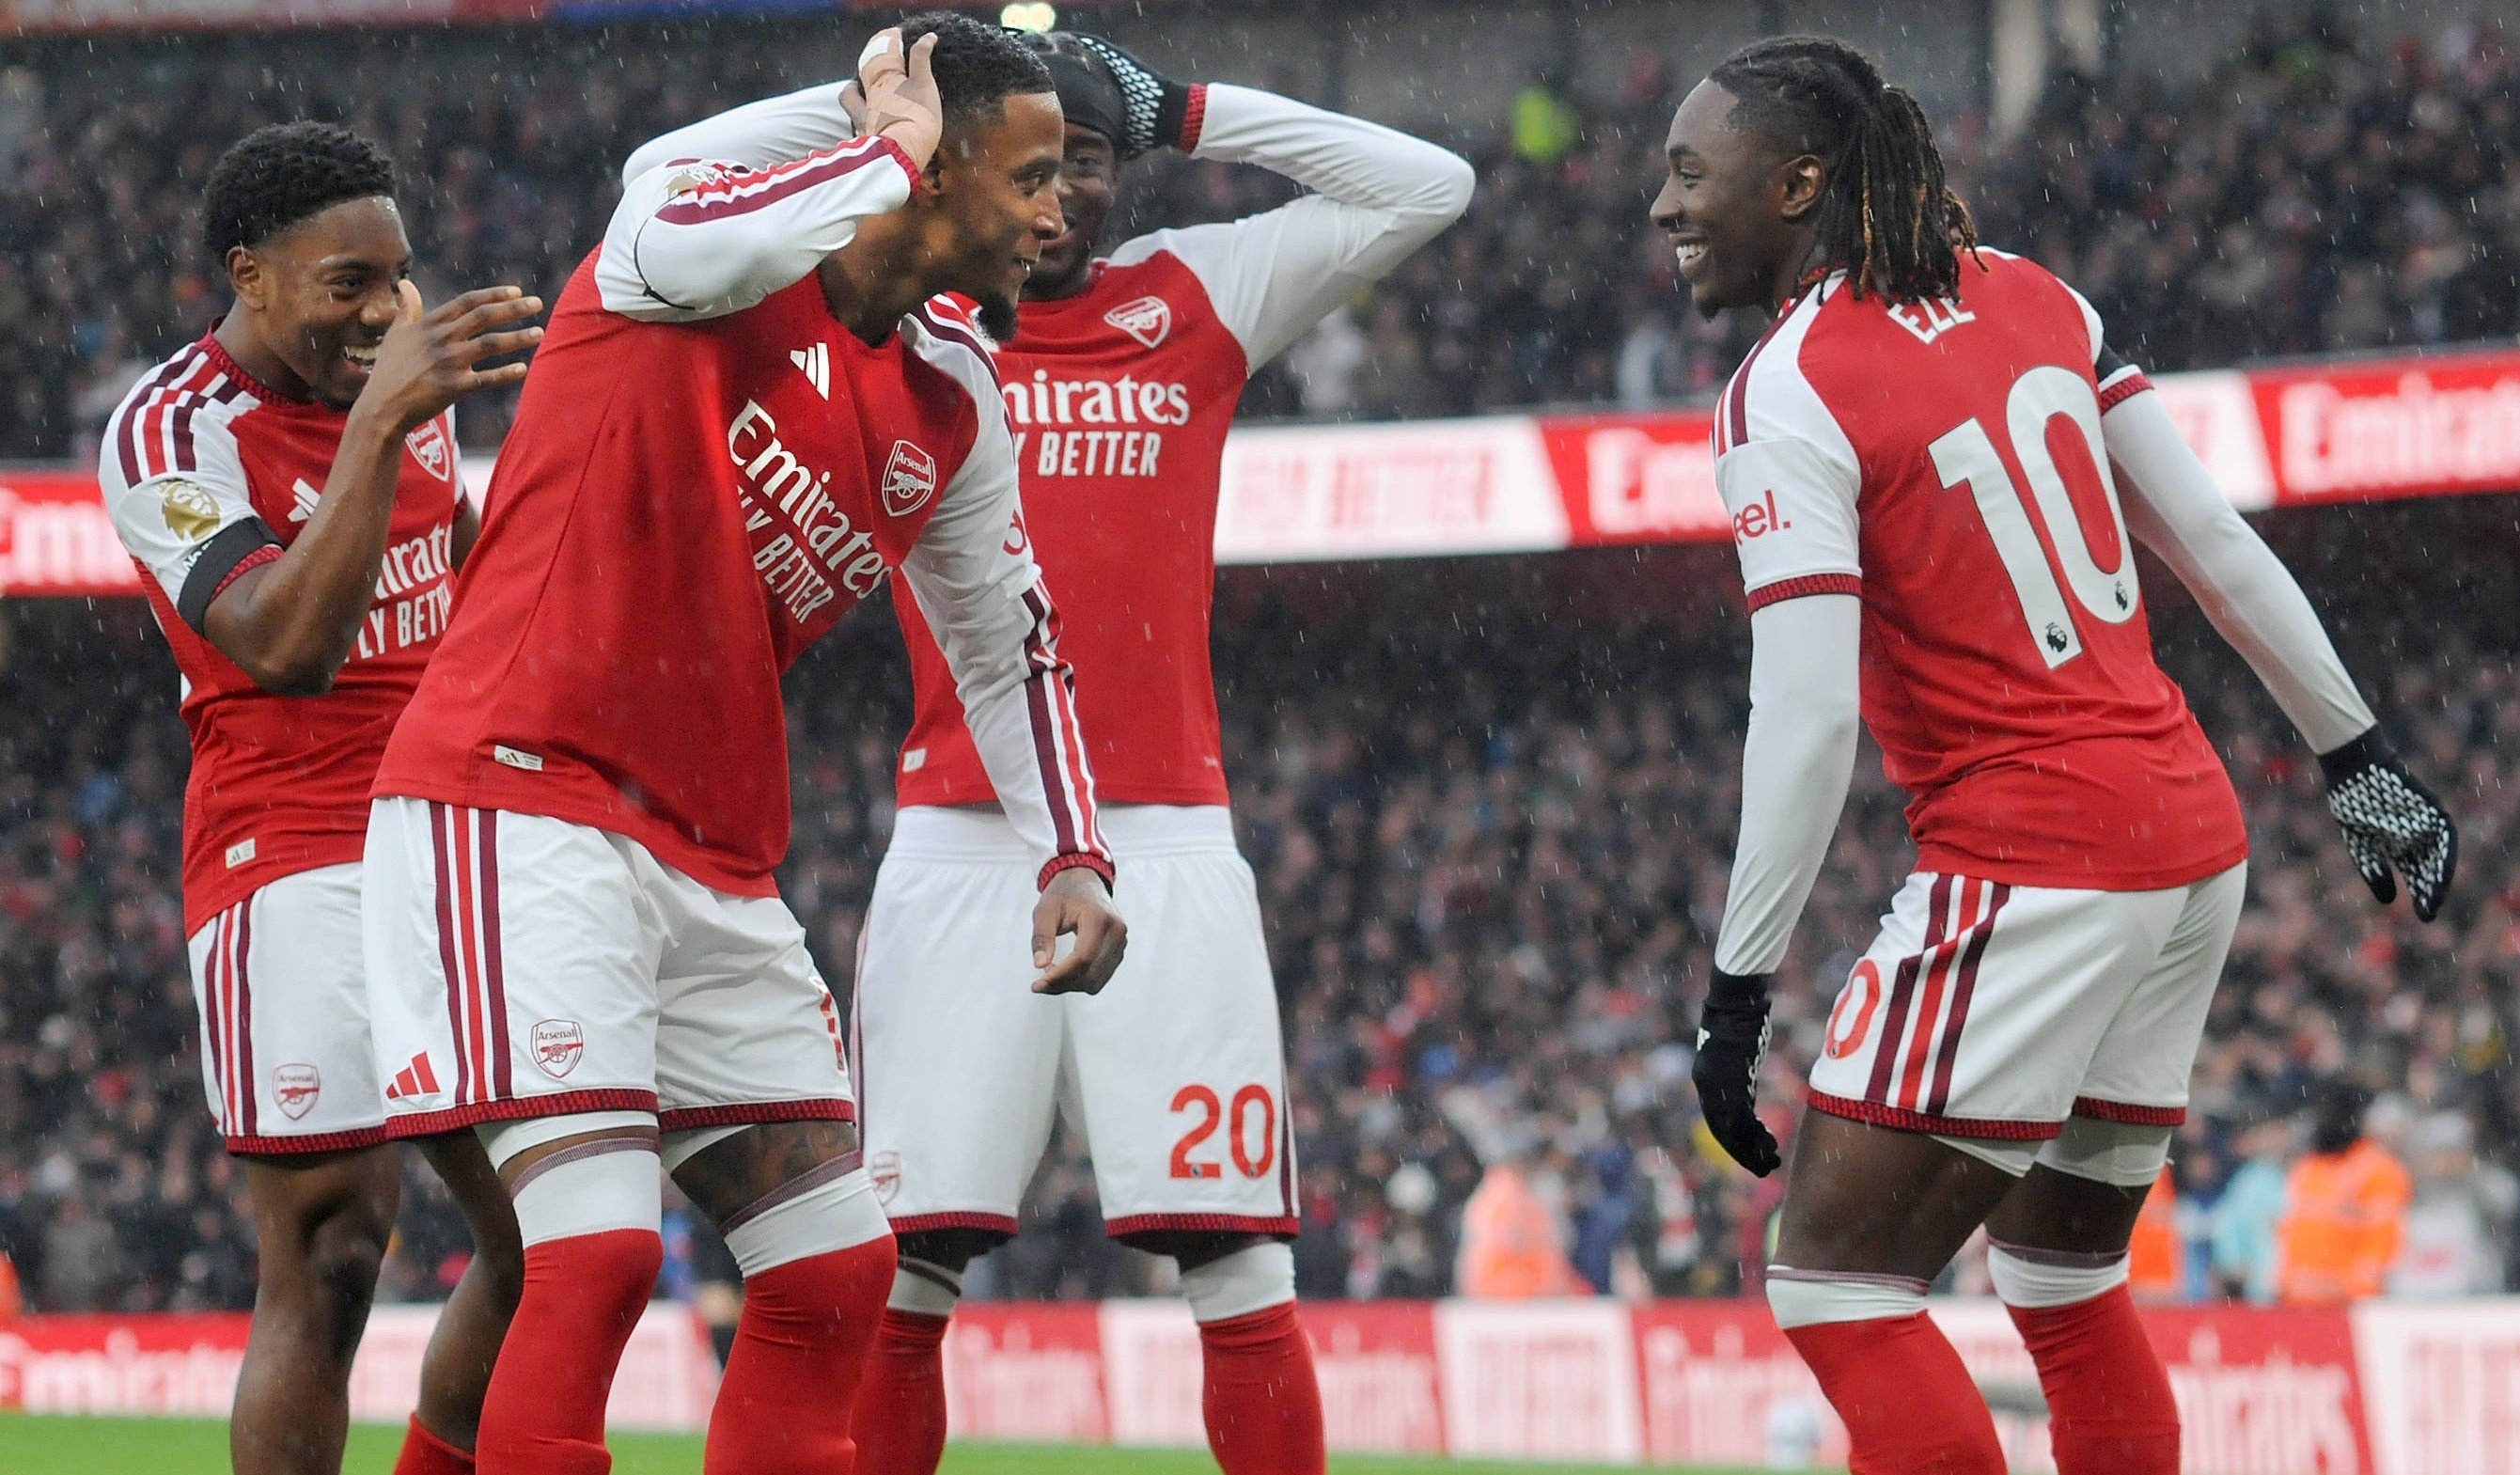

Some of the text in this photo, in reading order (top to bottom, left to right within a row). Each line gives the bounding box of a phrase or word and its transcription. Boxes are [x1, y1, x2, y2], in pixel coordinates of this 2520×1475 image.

[897, 451, 931, 476] Arsenal
[1037, 431, 1162, 477] BETTER
[728, 398, 893, 600] Emirates
[1927, 365, 2140, 670] 10
[374, 520, 452, 600] irat
[753, 533, 835, 624] BETTER
[346, 607, 386, 662] LY
[538, 1028, 577, 1041] Arsenal
[1170, 1084, 1275, 1180] 20
